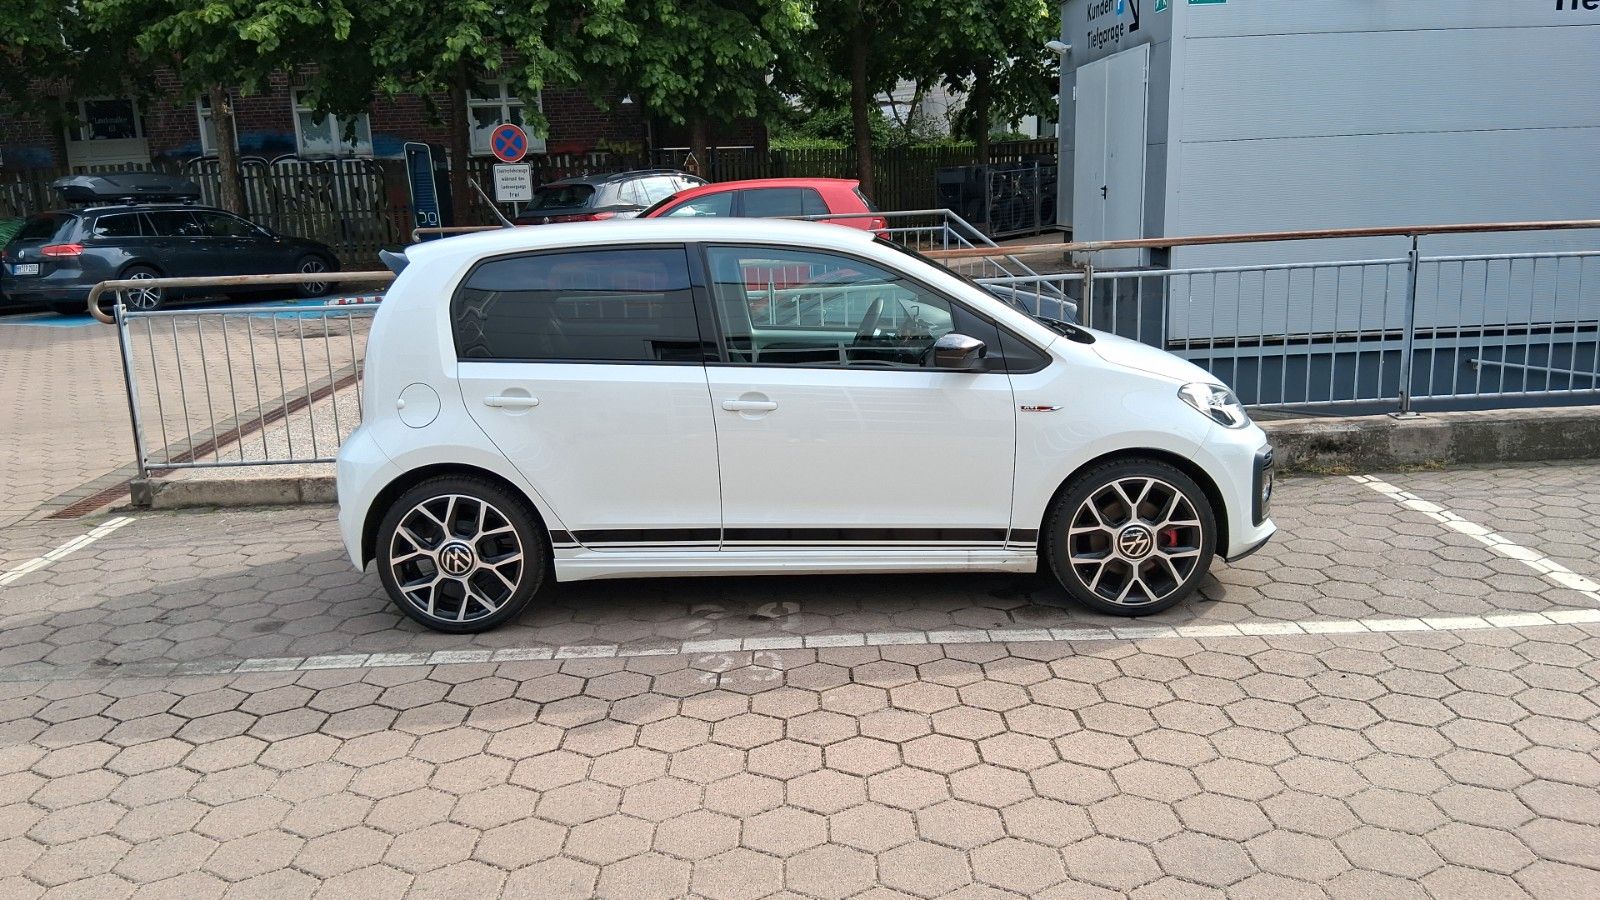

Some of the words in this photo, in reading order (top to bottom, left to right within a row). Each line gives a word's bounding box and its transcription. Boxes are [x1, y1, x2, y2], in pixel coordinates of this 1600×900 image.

[1087, 0, 1114, 22] Kunden
[1087, 22, 1124, 49] Tiefgarage
[699, 652, 783, 684] 29
